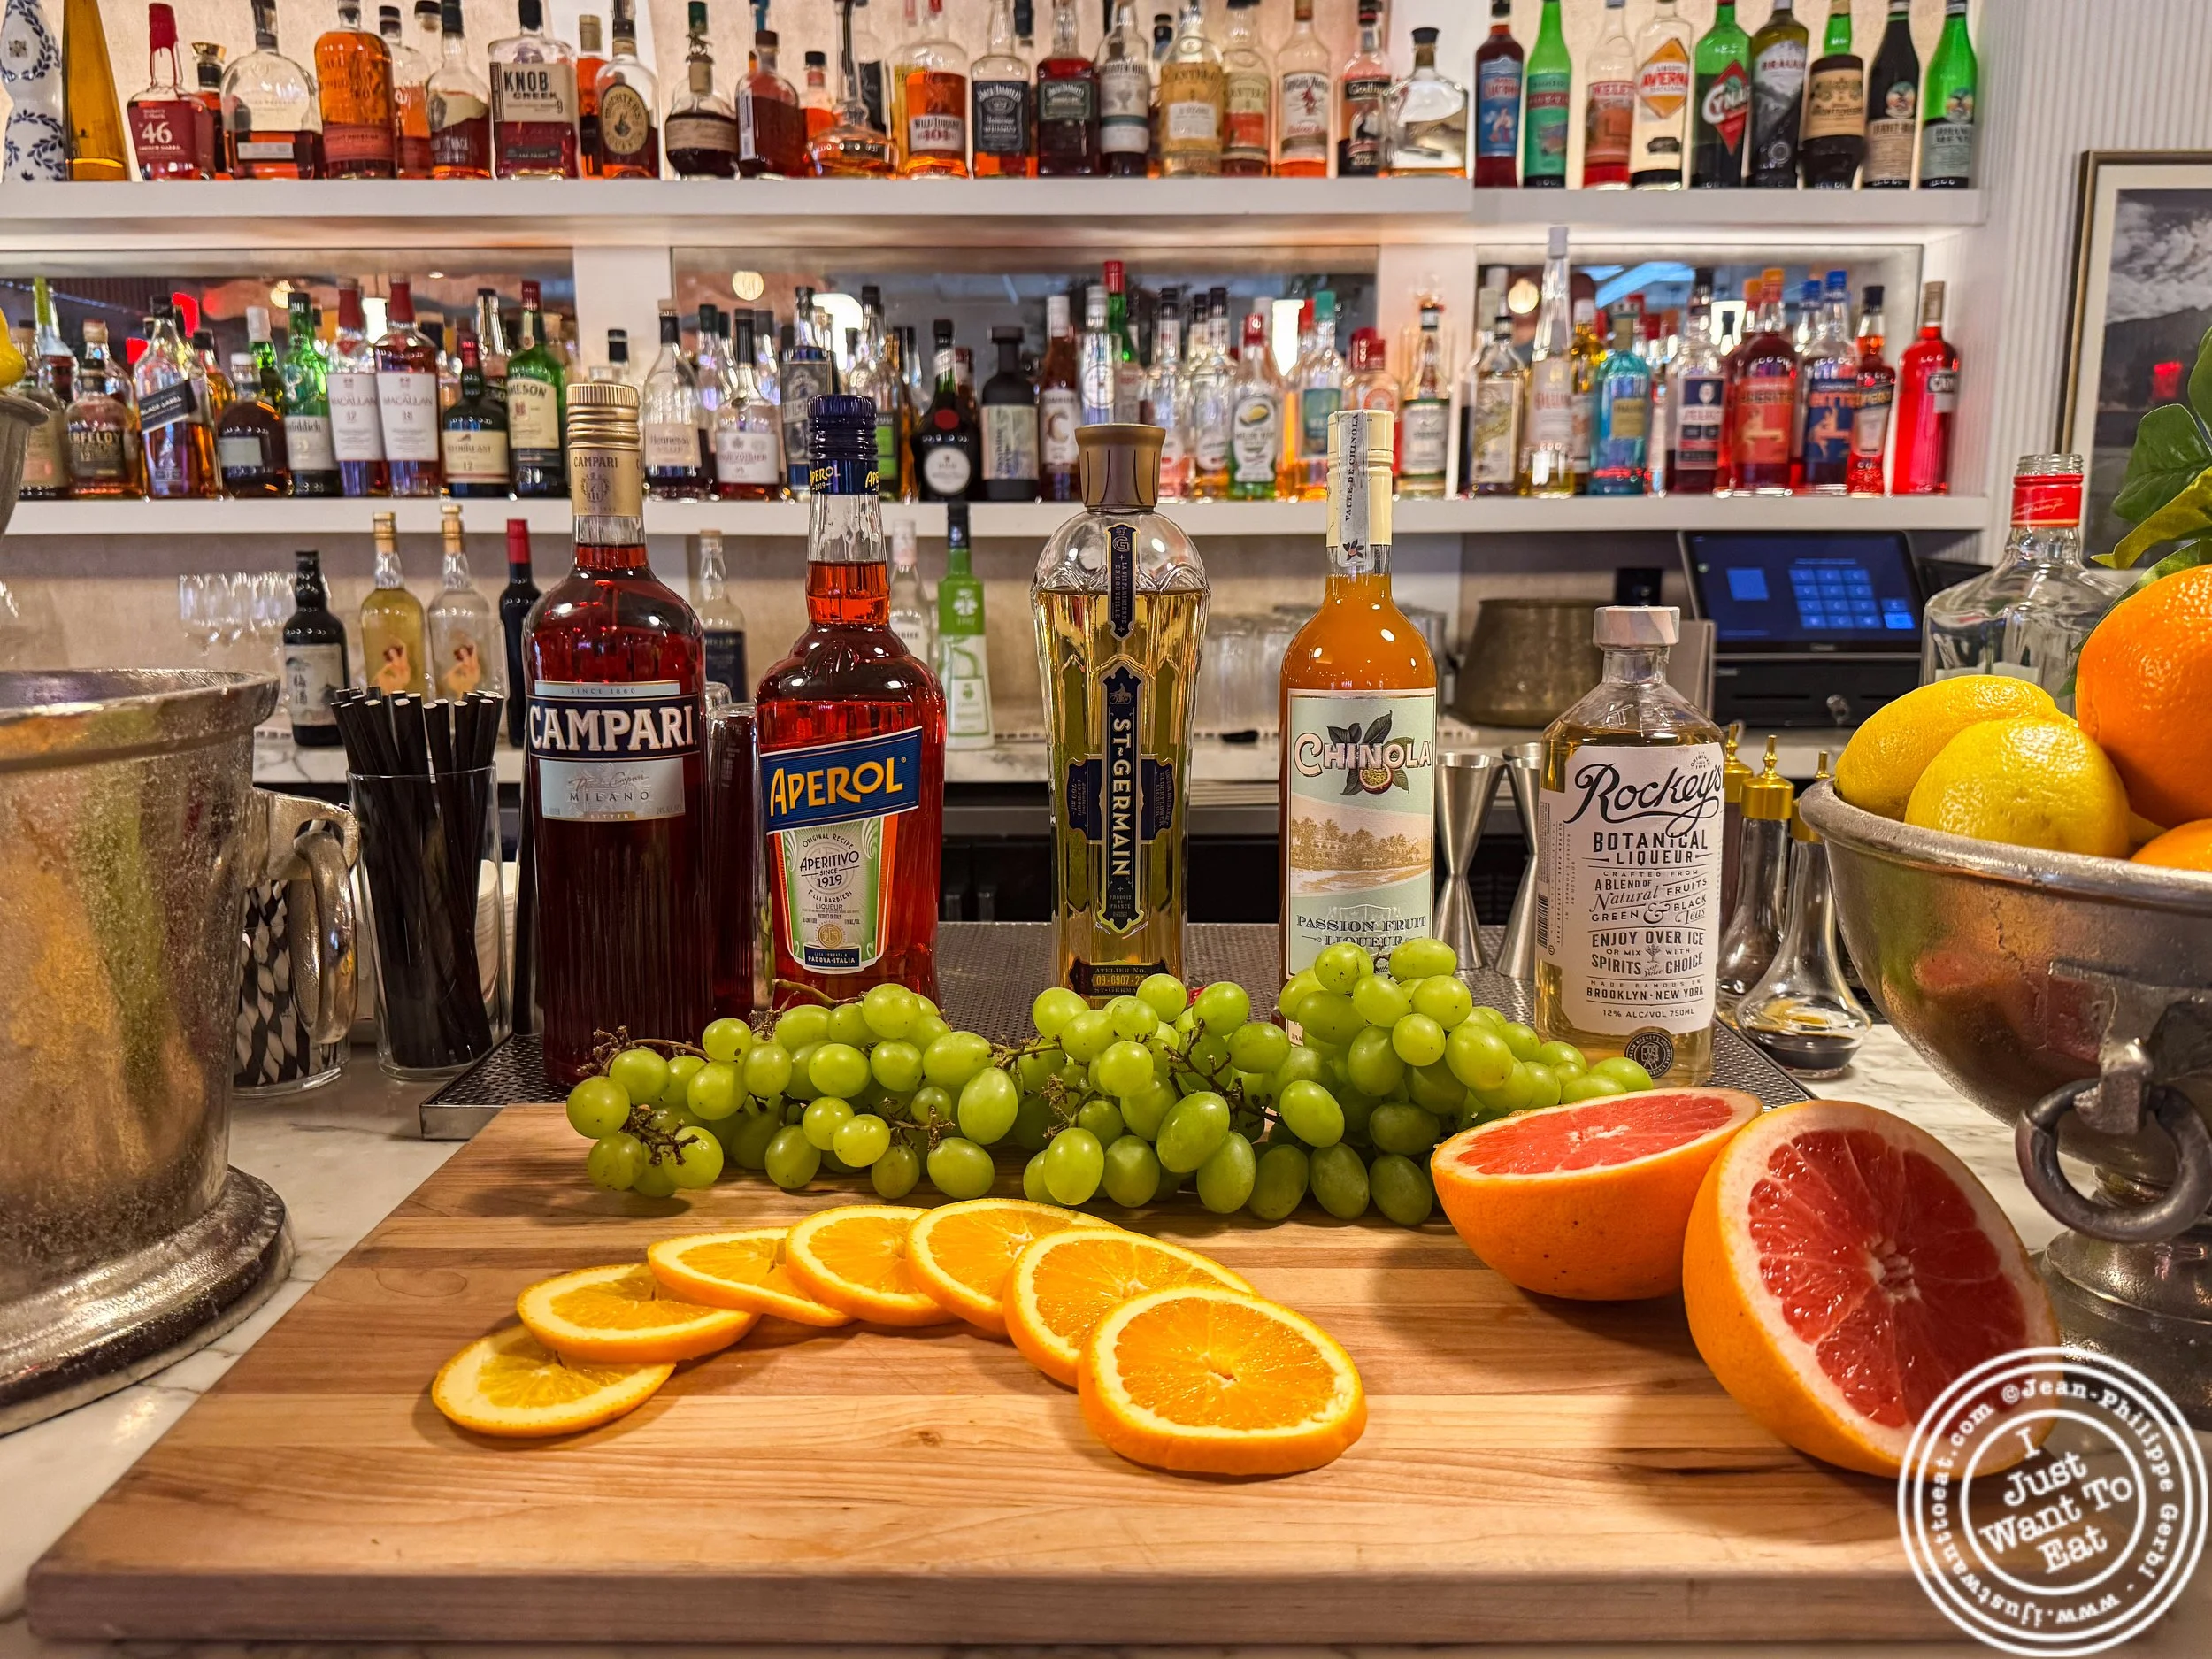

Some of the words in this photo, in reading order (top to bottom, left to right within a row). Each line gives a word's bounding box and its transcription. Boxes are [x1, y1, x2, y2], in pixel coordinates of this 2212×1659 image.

[503, 71, 549, 91] KNOB
[512, 91, 557, 100] CREEK
[142, 121, 173, 144] 46
[650, 434, 691, 446] Hennessy
[1348, 414, 1359, 465] CHINOLA
[573, 456, 618, 469] CAMPARI
[1348, 470, 1355, 484] DE
[1345, 487, 1354, 521] VALLE
[530, 704, 695, 751] CAMPARI
[1294, 732, 1432, 778] CHINOLA
[570, 790, 650, 803] MILANO
[770, 757, 904, 818] APEROL
[1563, 763, 1723, 838] Rockey's
[802, 833, 830, 848] ORIGINAL
[833, 833, 855, 849] RECIPE
[1593, 829, 1709, 853] BOTANICAL
[800, 850, 860, 872] APERITIVO
[1616, 850, 1693, 865] LIQUEUR
[816, 874, 842, 888] 1919
[1605, 879, 1641, 890] BLEND
[824, 890, 853, 902] BARBIERI
[1589, 886, 1660, 912] Natural
[1666, 878, 1708, 896] FRUITS
[1591, 910, 1639, 922] GREEN
[1643, 902, 1671, 924] &
[1673, 894, 1707, 912] BLACK
[1675, 907, 1706, 925] Teas
[1296, 914, 1375, 933] PASSION
[1382, 915, 1427, 932] FRUIT
[1325, 934, 1402, 948] LIQUEUR
[1592, 931, 1639, 948] ENJOY
[1645, 930, 1682, 945] OVER
[1687, 932, 1704, 946] ICE
[1591, 954, 1641, 975] SPIRITS
[1665, 951, 1703, 974] CHOICE
[1590, 979, 1624, 988] MADE
[1586, 987, 1647, 1001] BROOKLYN
[1655, 988, 1680, 1000] NEW
[1683, 986, 1704, 998] YORK
[1602, 1009, 1622, 1018] 12%
[1625, 1009, 1667, 1019] ALC/VOL
[1669, 1008, 1695, 1017] 750ML
